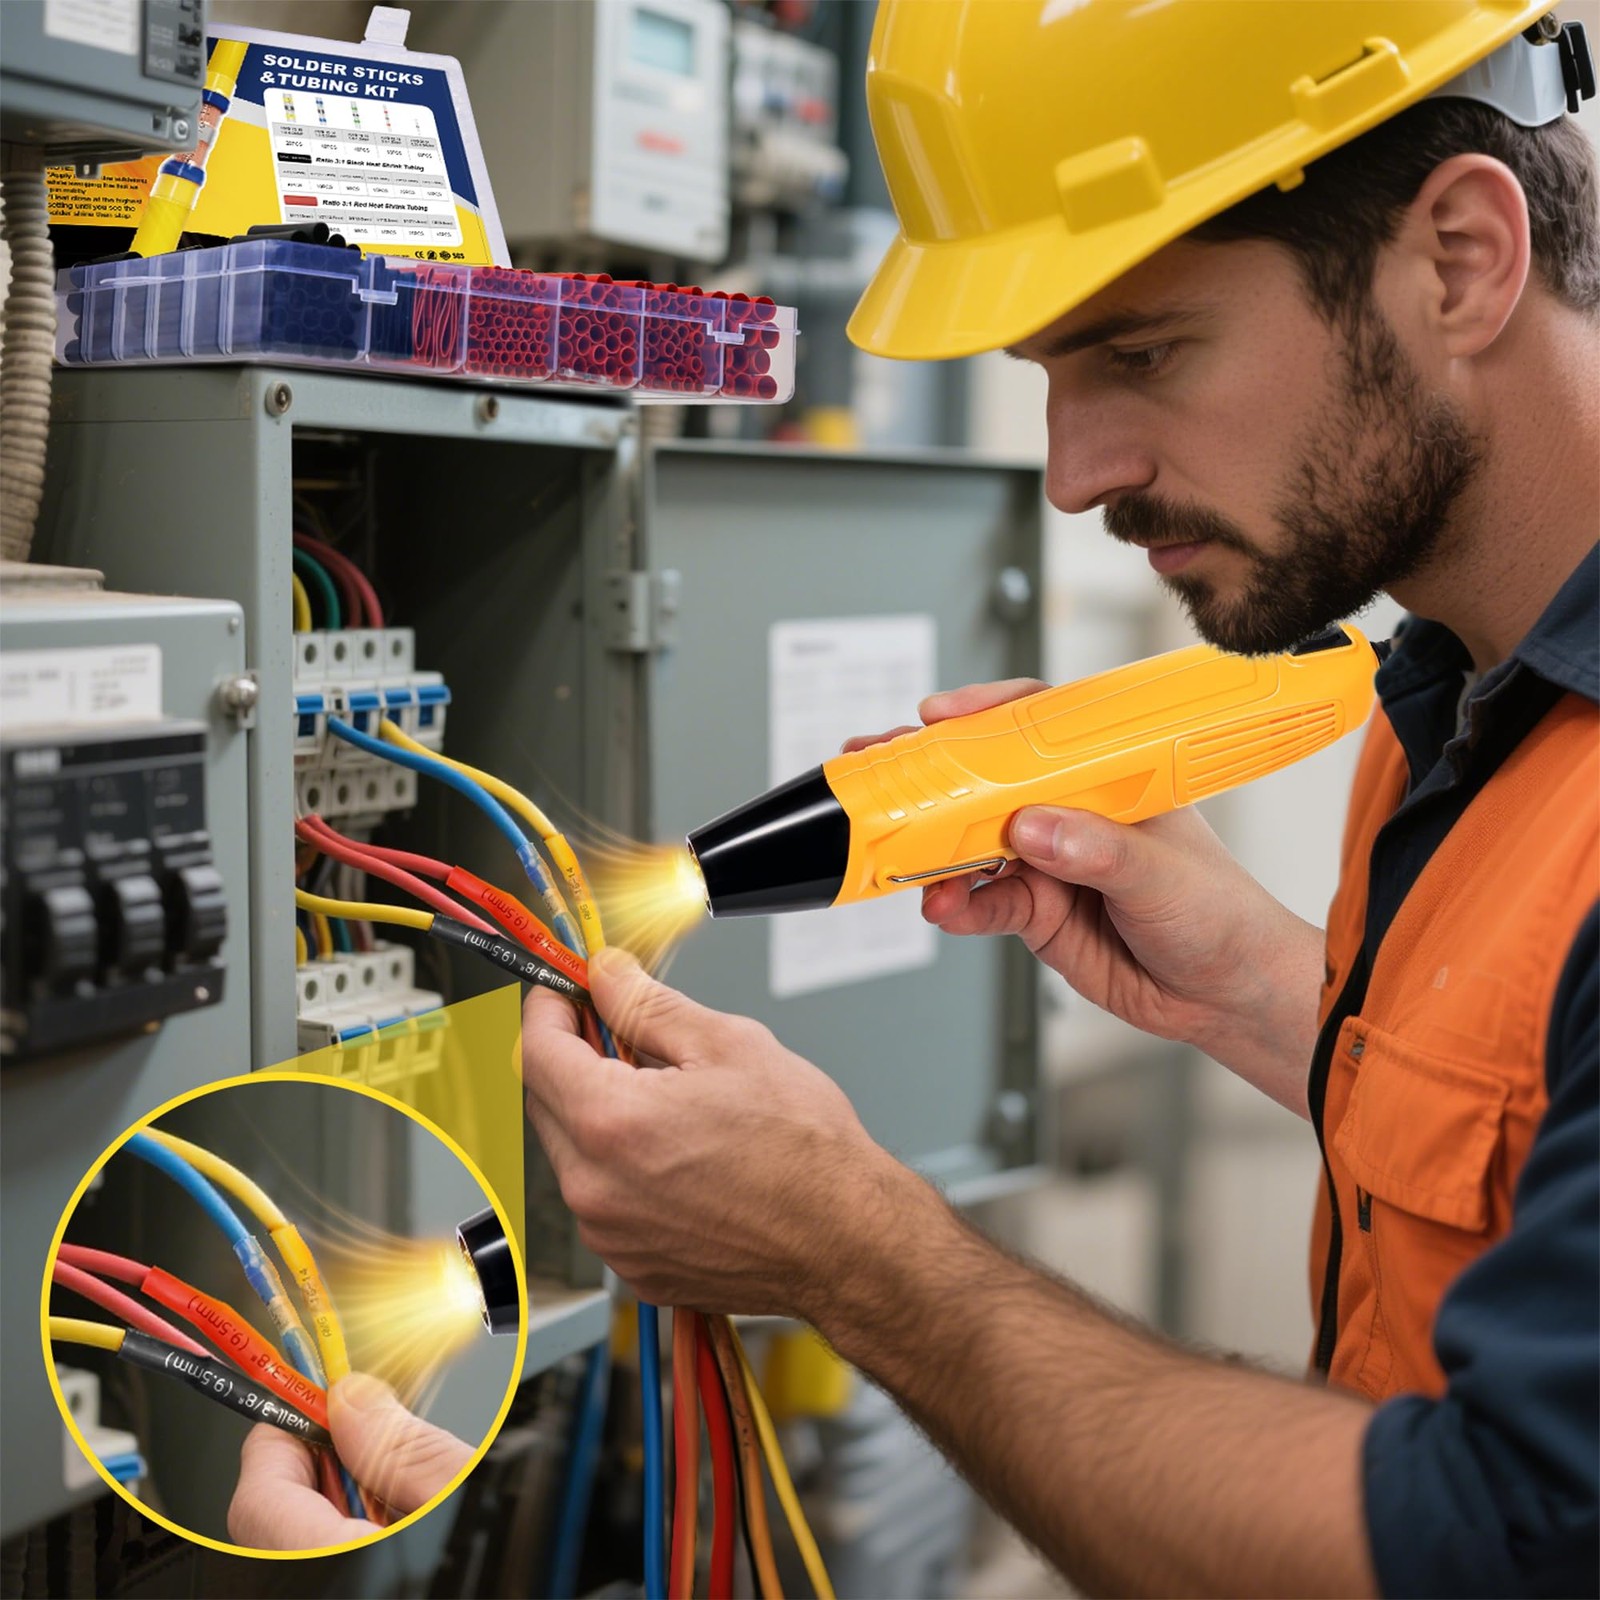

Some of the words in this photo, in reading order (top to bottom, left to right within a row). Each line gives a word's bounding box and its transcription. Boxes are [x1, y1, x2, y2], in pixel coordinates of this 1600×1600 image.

[263, 54, 347, 76] SOLDER
[353, 66, 424, 86] STICKS
[365, 84, 398, 98] KIT
[404, 164, 424, 172] Tubing
[407, 204, 428, 212] Tubing
[481, 888, 529, 930] (9.5mm)
[464, 931, 517, 966] (9.5mm)
[187, 1295, 250, 1351] (9.5mm)
[164, 1351, 233, 1398] (9.5mm)
